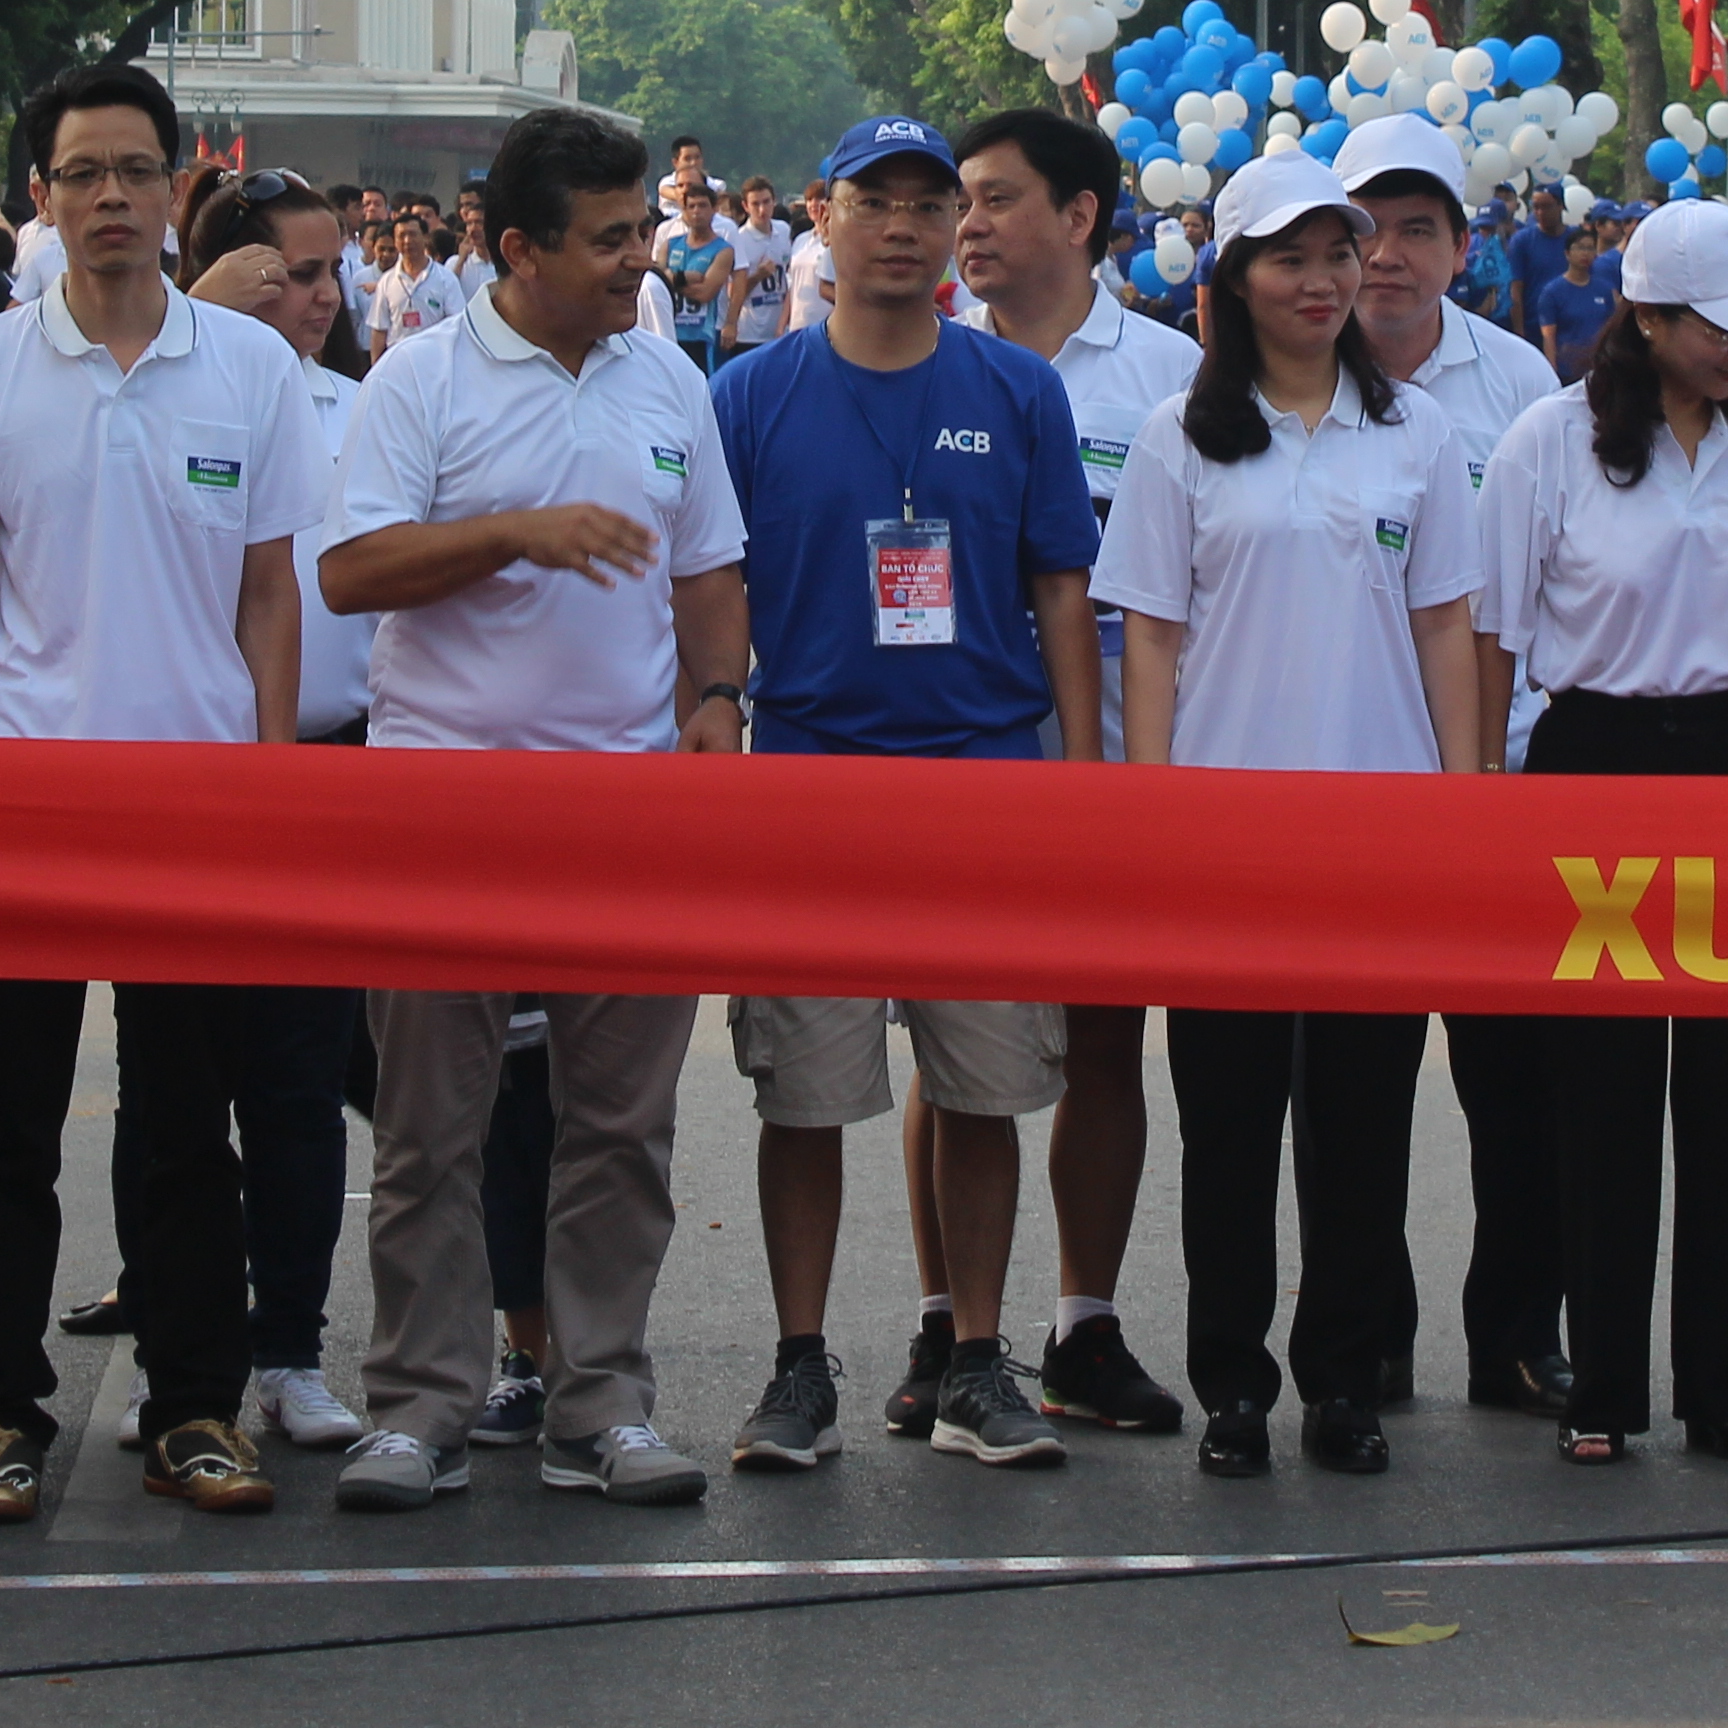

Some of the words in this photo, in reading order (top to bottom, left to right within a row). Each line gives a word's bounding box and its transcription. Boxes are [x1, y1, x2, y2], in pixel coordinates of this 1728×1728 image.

[874, 121, 925, 139] ACB
[934, 428, 991, 454] ACB
[881, 563, 901, 574] BAN
